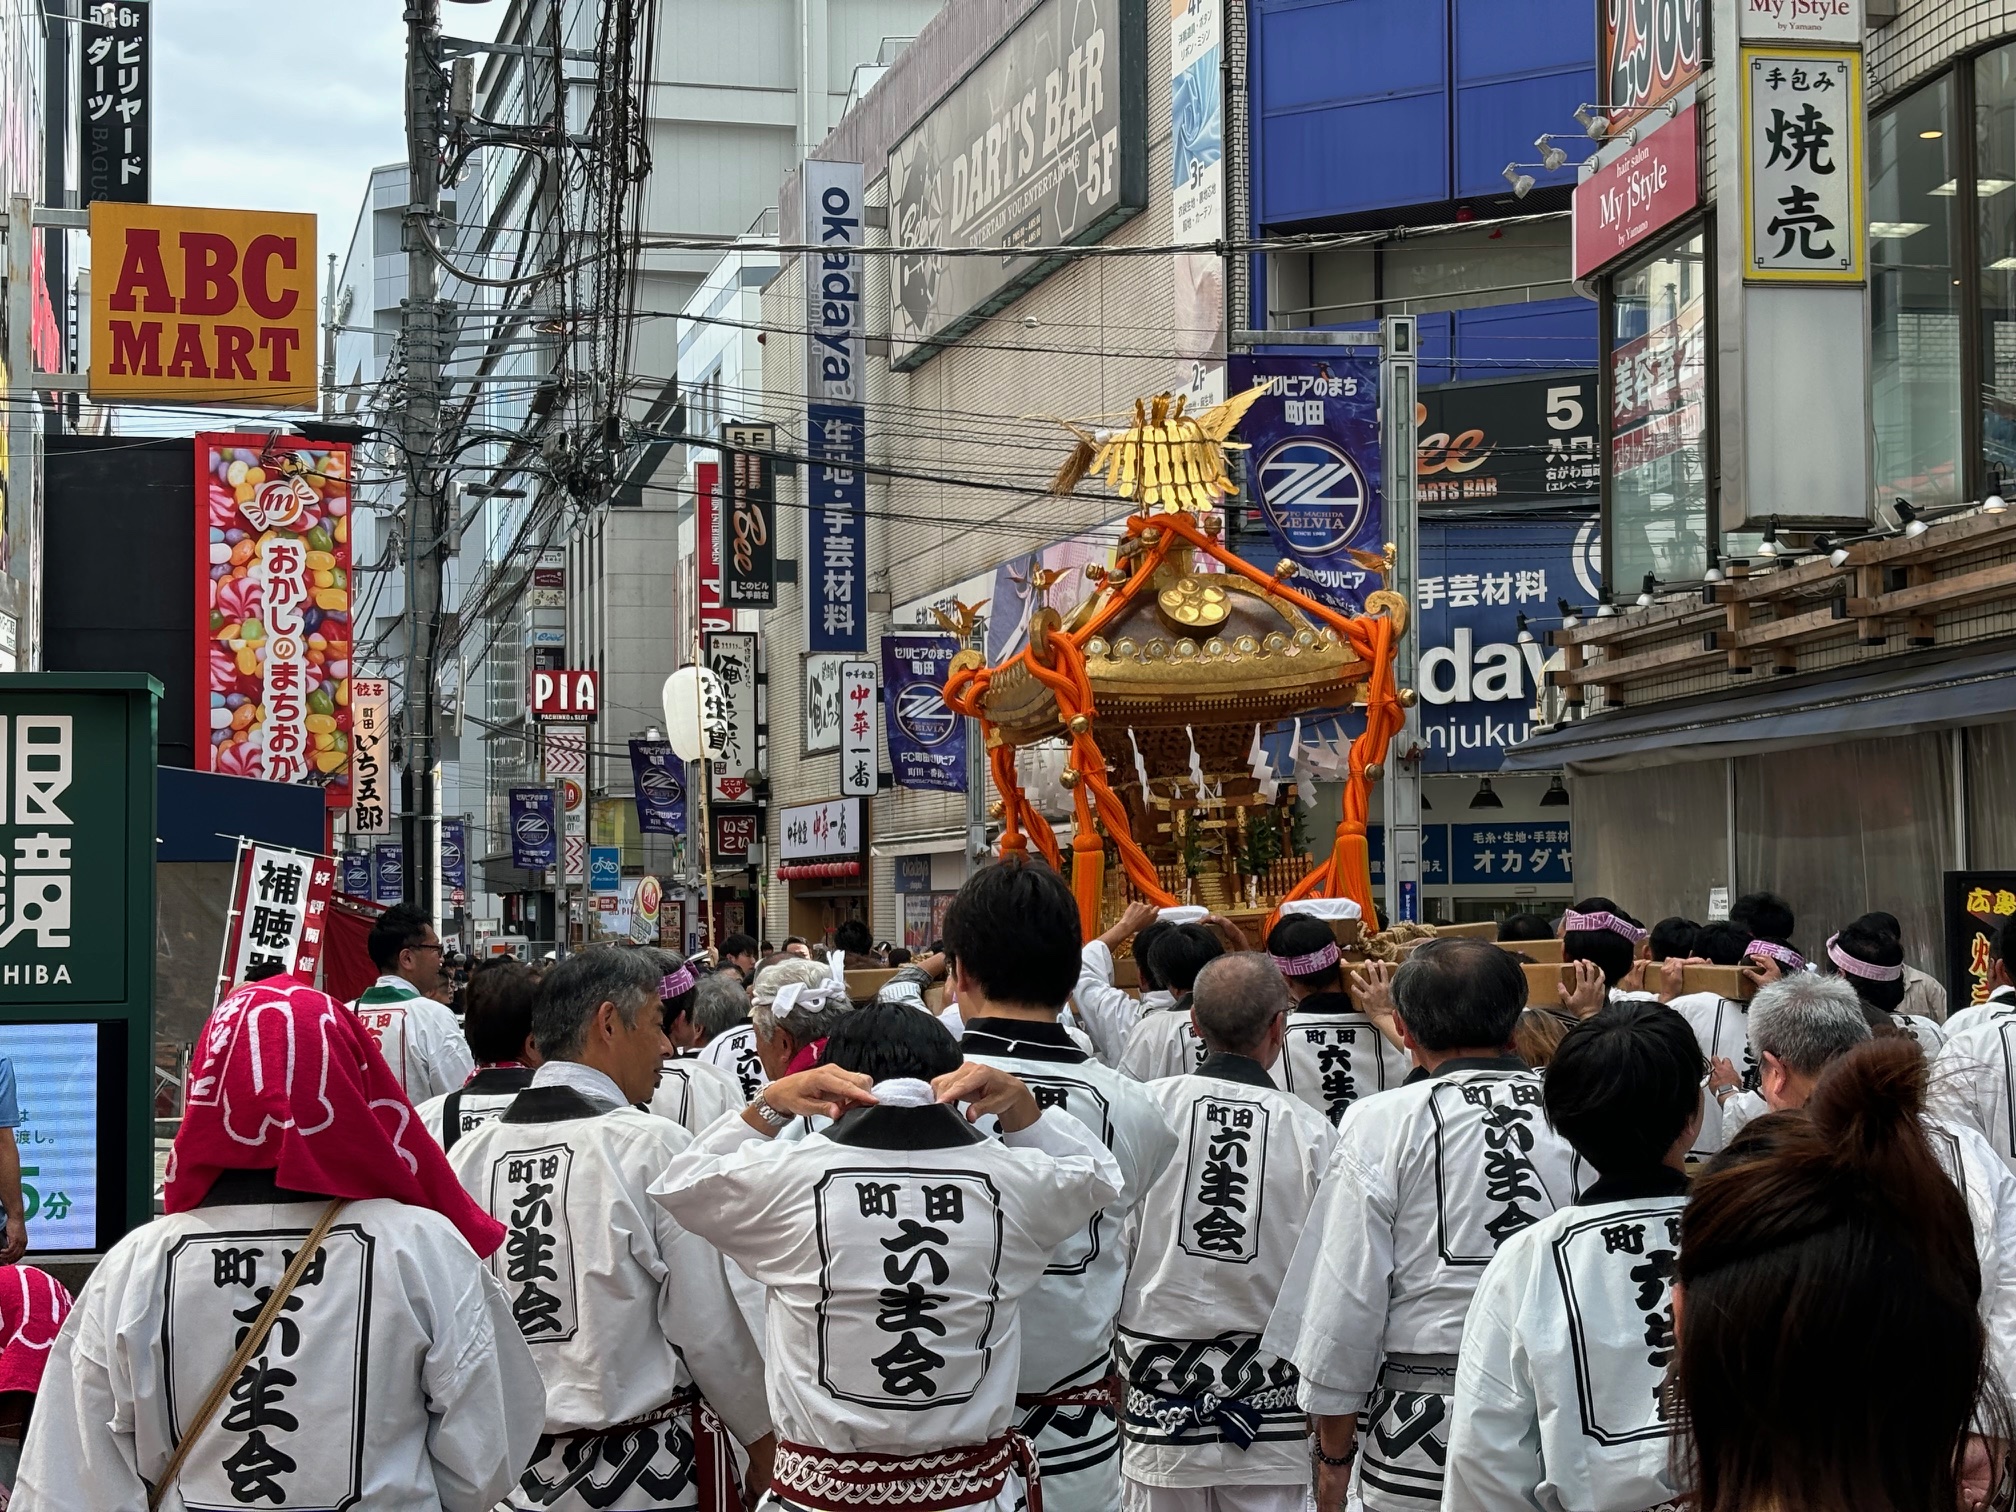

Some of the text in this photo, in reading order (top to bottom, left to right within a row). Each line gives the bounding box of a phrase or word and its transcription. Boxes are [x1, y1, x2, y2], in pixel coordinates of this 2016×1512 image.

[1748, 0, 1850, 22] My jStyle
[1777, 21, 1823, 32] by Yamano
[86, 35, 115, 122] ダーツ
[1764, 66, 1836, 93] 手包み
[115, 36, 143, 186] ビリヤード
[950, 28, 1105, 234] DART'S BAR
[91, 127, 109, 201] BAGUS
[1086, 125, 1118, 206] 5F
[1190, 160, 1204, 191] 3F
[1616, 145, 1650, 179] hair salon
[1764, 102, 1837, 260] 焼売
[1599, 156, 1668, 232] My jStyle
[1617, 218, 1649, 250] by Yamano
[109, 228, 300, 320] ABC
[814, 186, 860, 383] okadaya
[108, 319, 300, 382] MART
[1192, 363, 1205, 393] 2F
[1252, 374, 1359, 397] ゼルビアのまち
[1613, 335, 1678, 419] 美容室
[1284, 400, 1325, 426] 町田
[733, 431, 766, 447] 5F
[1418, 401, 1498, 475] ee
[1545, 435, 1600, 464] 入口
[1463, 477, 1499, 499] BAR
[822, 418, 855, 637] 生地・手芸材料
[1273, 510, 1346, 530] ZELVIA
[1290, 510, 1301, 518] FC
[733, 503, 767, 577] Bee
[739, 581, 769, 591] このビル
[1417, 568, 1549, 611] 手芸材料
[268, 544, 302, 782] おかしのまちおか
[912, 661, 935, 676] 町田
[353, 682, 385, 697] 餃子
[535, 673, 595, 711] PIA
[362, 707, 375, 730] 町田
[848, 683, 871, 789] 中華一番
[906, 720, 946, 733] ZELVIA
[354, 734, 384, 832] いち五郎
[813, 801, 847, 851] 中華一番
[1472, 830, 1570, 845] 毛糸・生地・手芸材
[298, 869, 331, 973] 好評開催
[1305, 1028, 1357, 1045] 町田
[1206, 1103, 1254, 1128] 町田
[1461, 1083, 1544, 1107] 町田
[508, 1154, 559, 1184] 町田
[1193, 1126, 1249, 1255] 六生会
[854, 1181, 966, 1224] 町田
[212, 1246, 328, 1290] 町田
[506, 1183, 562, 1336] 六生会
[871, 1219, 951, 1398] 六生会
[220, 1283, 304, 1505] 六生会
